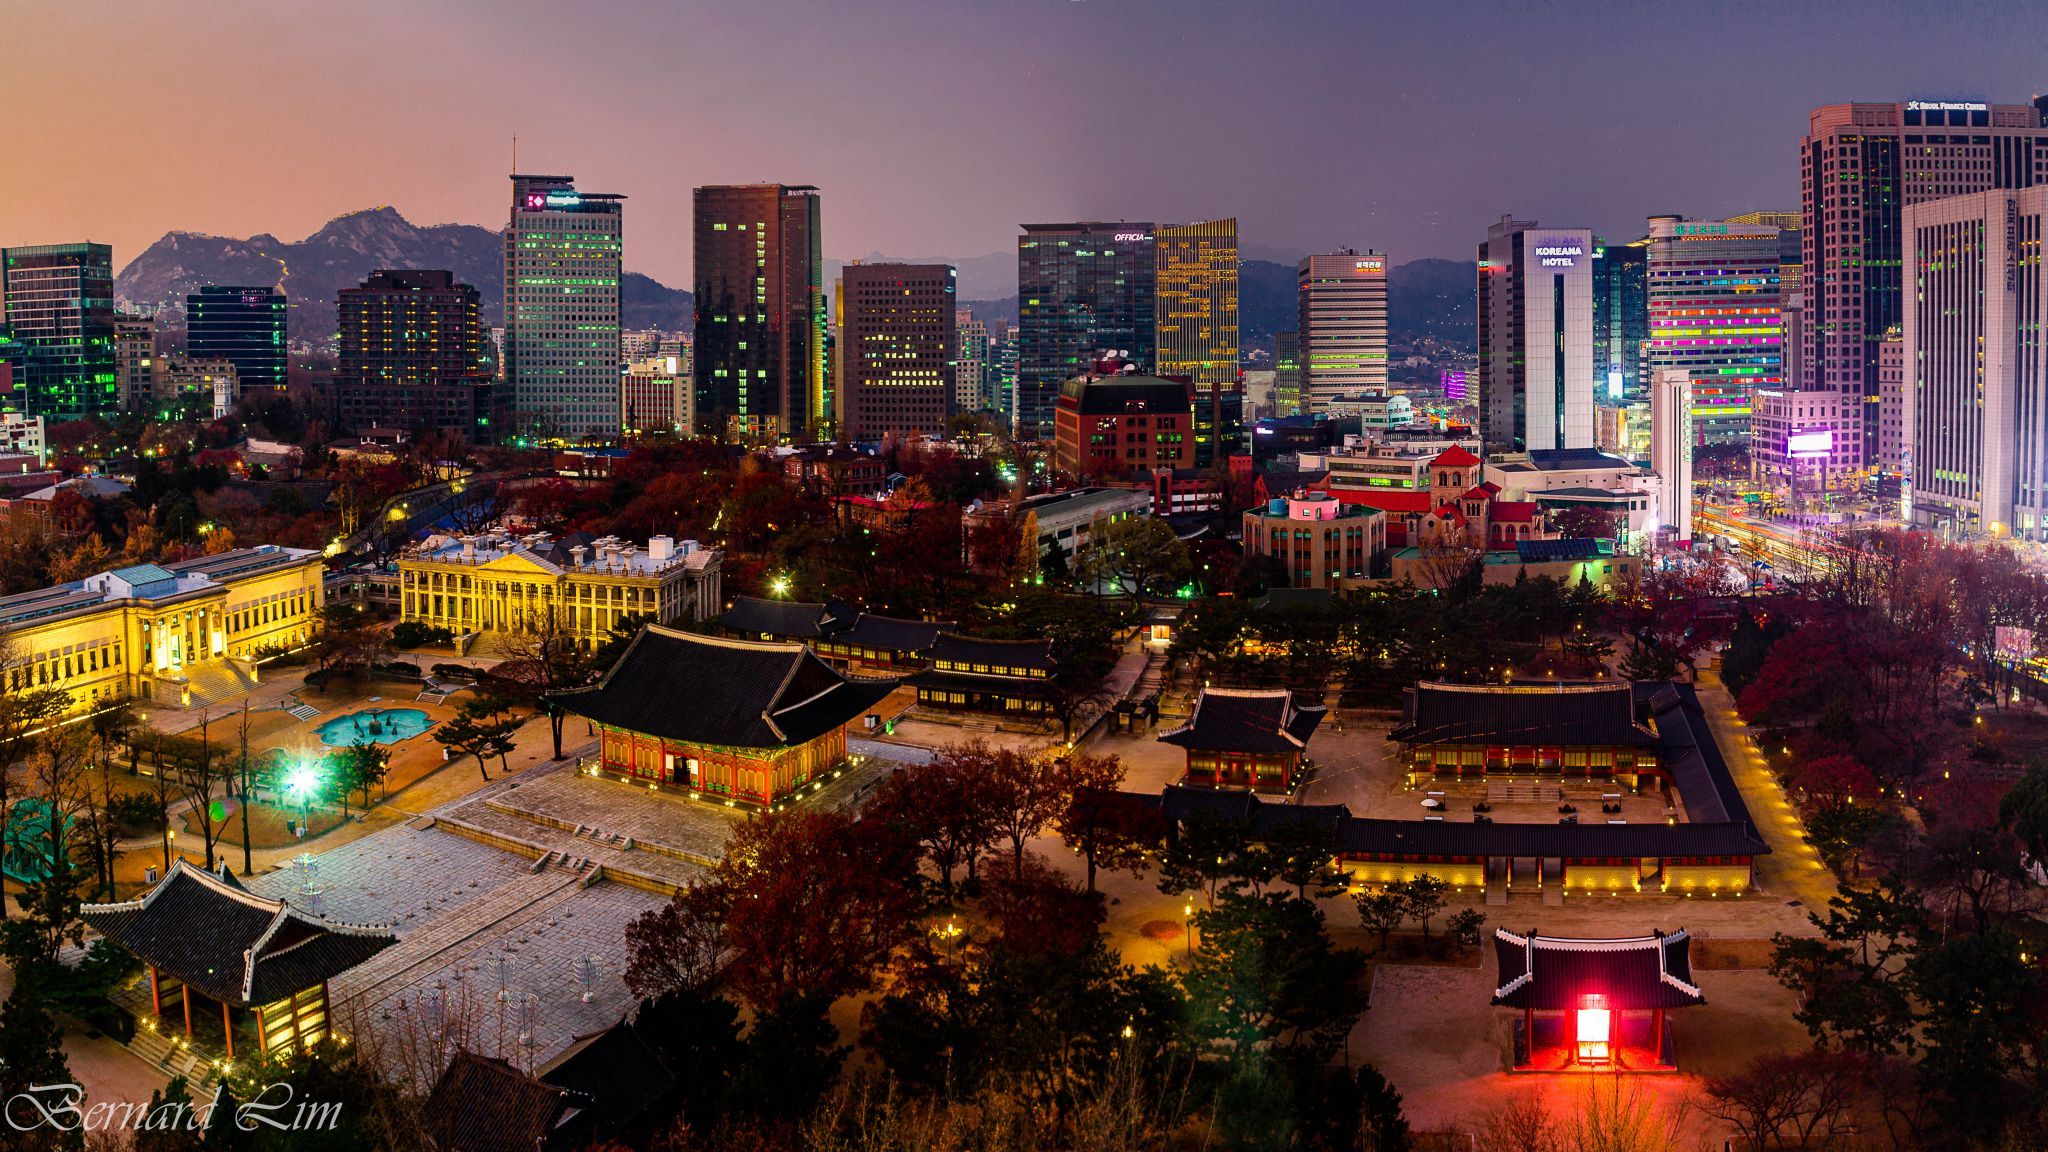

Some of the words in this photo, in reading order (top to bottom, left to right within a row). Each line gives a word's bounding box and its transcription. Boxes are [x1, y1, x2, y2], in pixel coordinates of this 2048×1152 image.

[1114, 233, 1144, 241] OFFICIA
[1535, 246, 1582, 256] KOREANA
[1542, 257, 1575, 267] HOTEL
